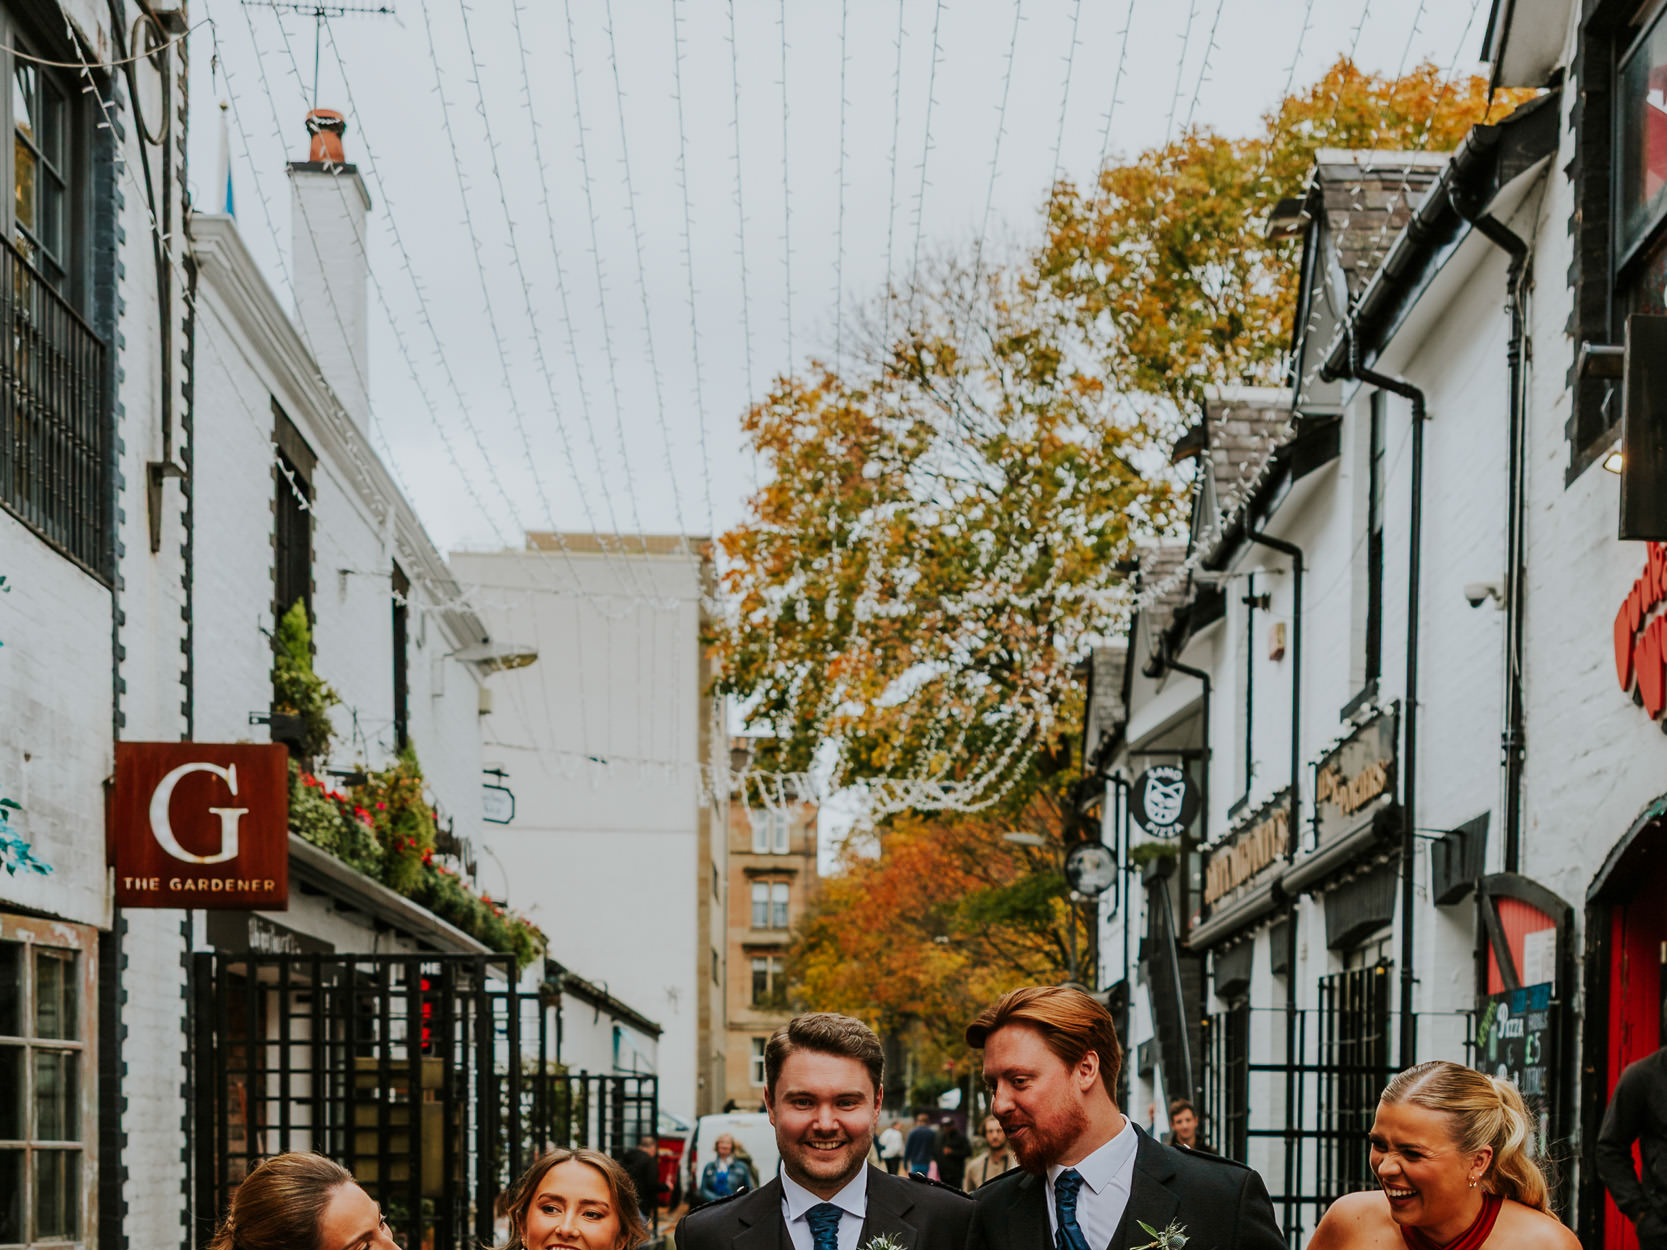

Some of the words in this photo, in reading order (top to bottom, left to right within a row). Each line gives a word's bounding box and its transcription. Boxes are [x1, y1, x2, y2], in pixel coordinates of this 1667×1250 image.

[149, 762, 249, 864] G
[1145, 821, 1184, 838] PIZZA
[124, 877, 160, 891] THE
[169, 877, 276, 892] GARDENER
